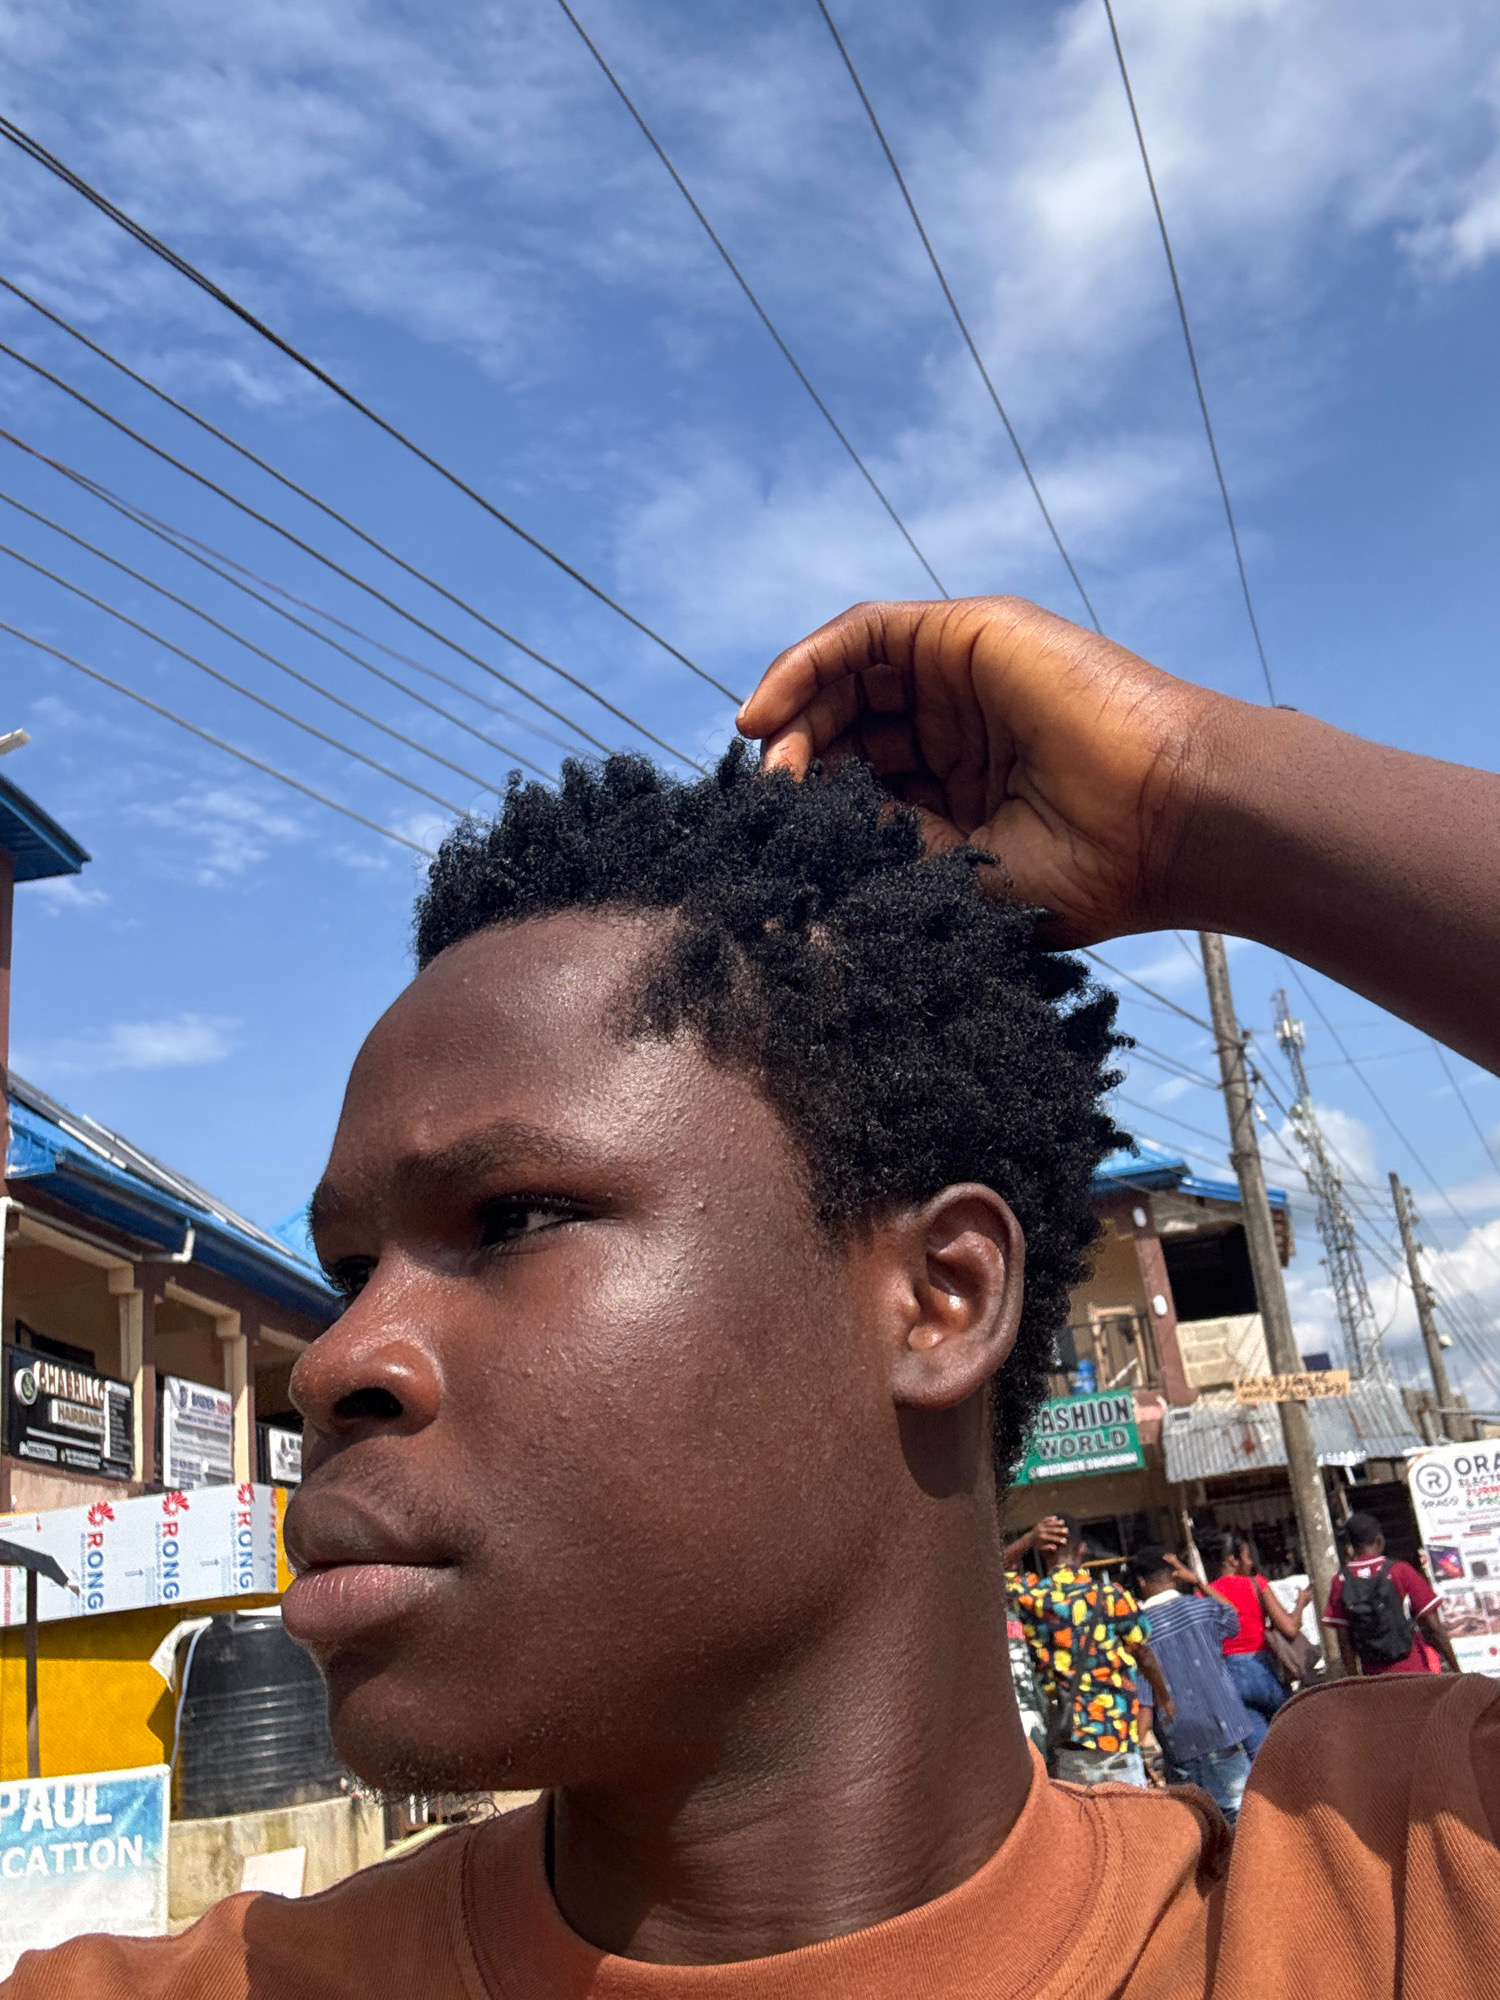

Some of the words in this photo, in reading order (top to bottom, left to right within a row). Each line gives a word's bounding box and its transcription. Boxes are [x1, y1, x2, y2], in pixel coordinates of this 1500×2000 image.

[1039, 1396, 1131, 1434] ASHION
[1037, 1428, 1128, 1459] WORLD
[87, 1531, 105, 1611] RONG
[161, 1521, 180, 1600] RONG
[237, 1511, 253, 1590] RONG
[0, 1783, 112, 1832] PAUL
[1, 1834, 143, 1879] CATION
